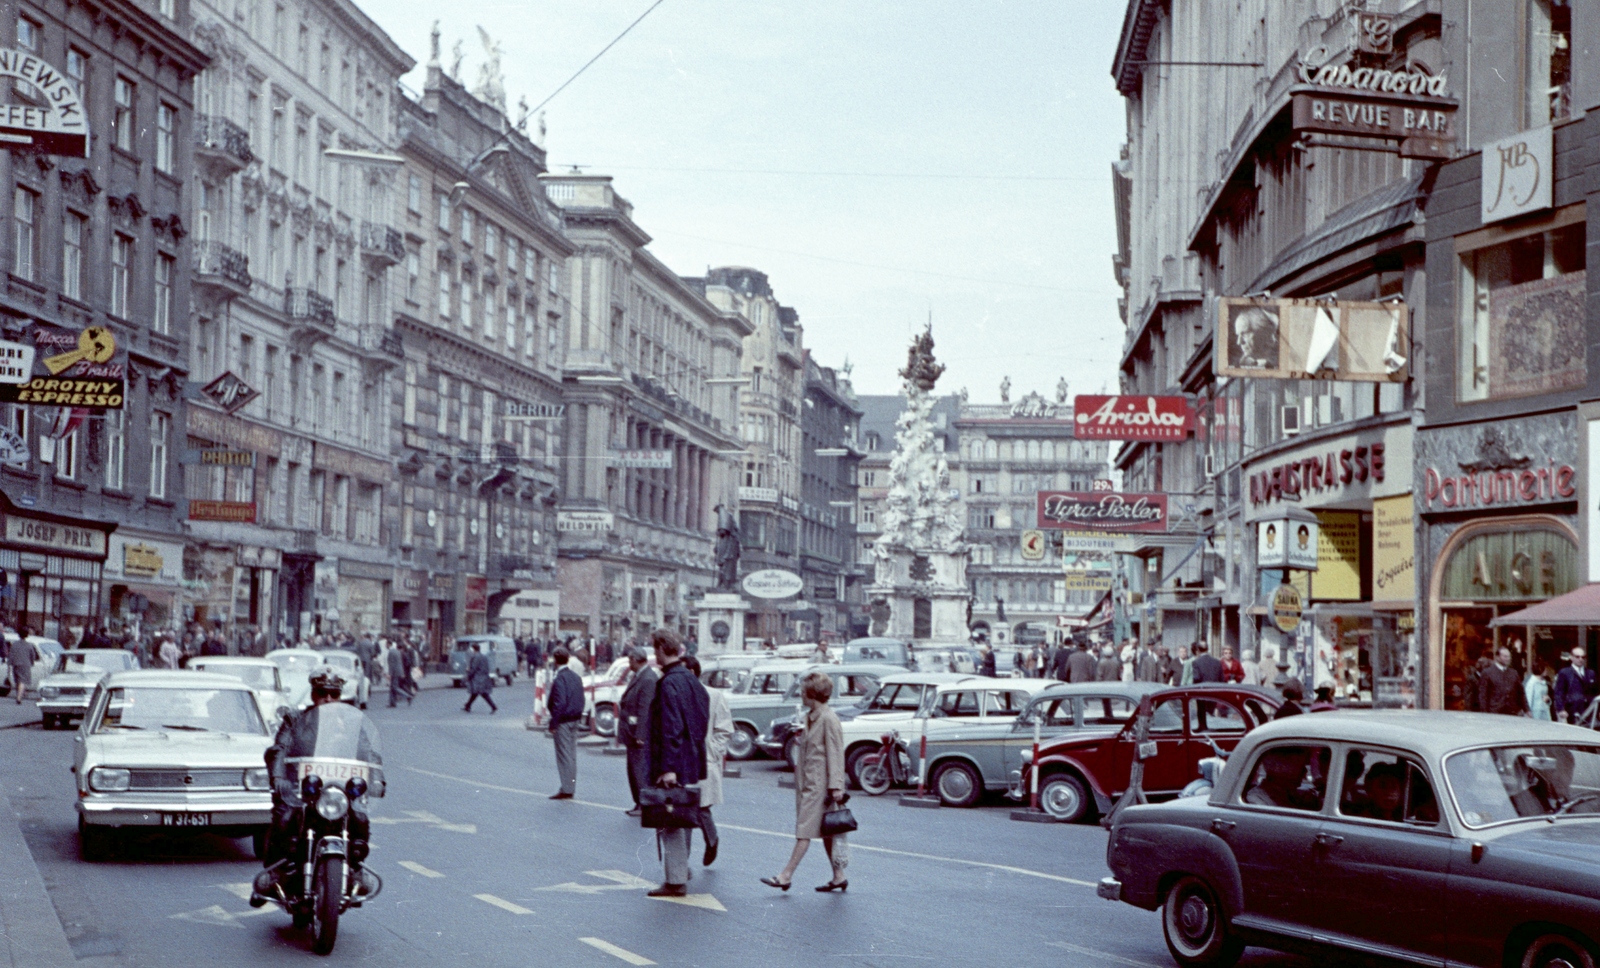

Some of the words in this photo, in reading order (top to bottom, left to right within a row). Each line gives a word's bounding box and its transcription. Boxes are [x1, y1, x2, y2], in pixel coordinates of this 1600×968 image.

[1301, 45, 1449, 97] Casanova
[0, 51, 82, 126] NIEWSKI
[1313, 100, 1390, 127] REVUE
[1403, 107, 1447, 132] BAR
[34, 328, 76, 344] Mocca
[76, 361, 122, 377] Brasil
[18, 390, 122, 406] ESPRESSO
[507, 404, 566, 417] BERLITZ
[1077, 397, 1185, 426] Ariola
[1080, 427, 1181, 437] SCHALLPLATTEN
[202, 452, 251, 466] PHOTO
[1098, 494, 1164, 519] Perlen
[17, 522, 56, 541] JOSEF
[64, 528, 92, 547] PRIX
[1067, 540, 1115, 548] BIJOUTERIE
[304, 765, 364, 779] POLIZEI
[163, 814, 173, 825] W
